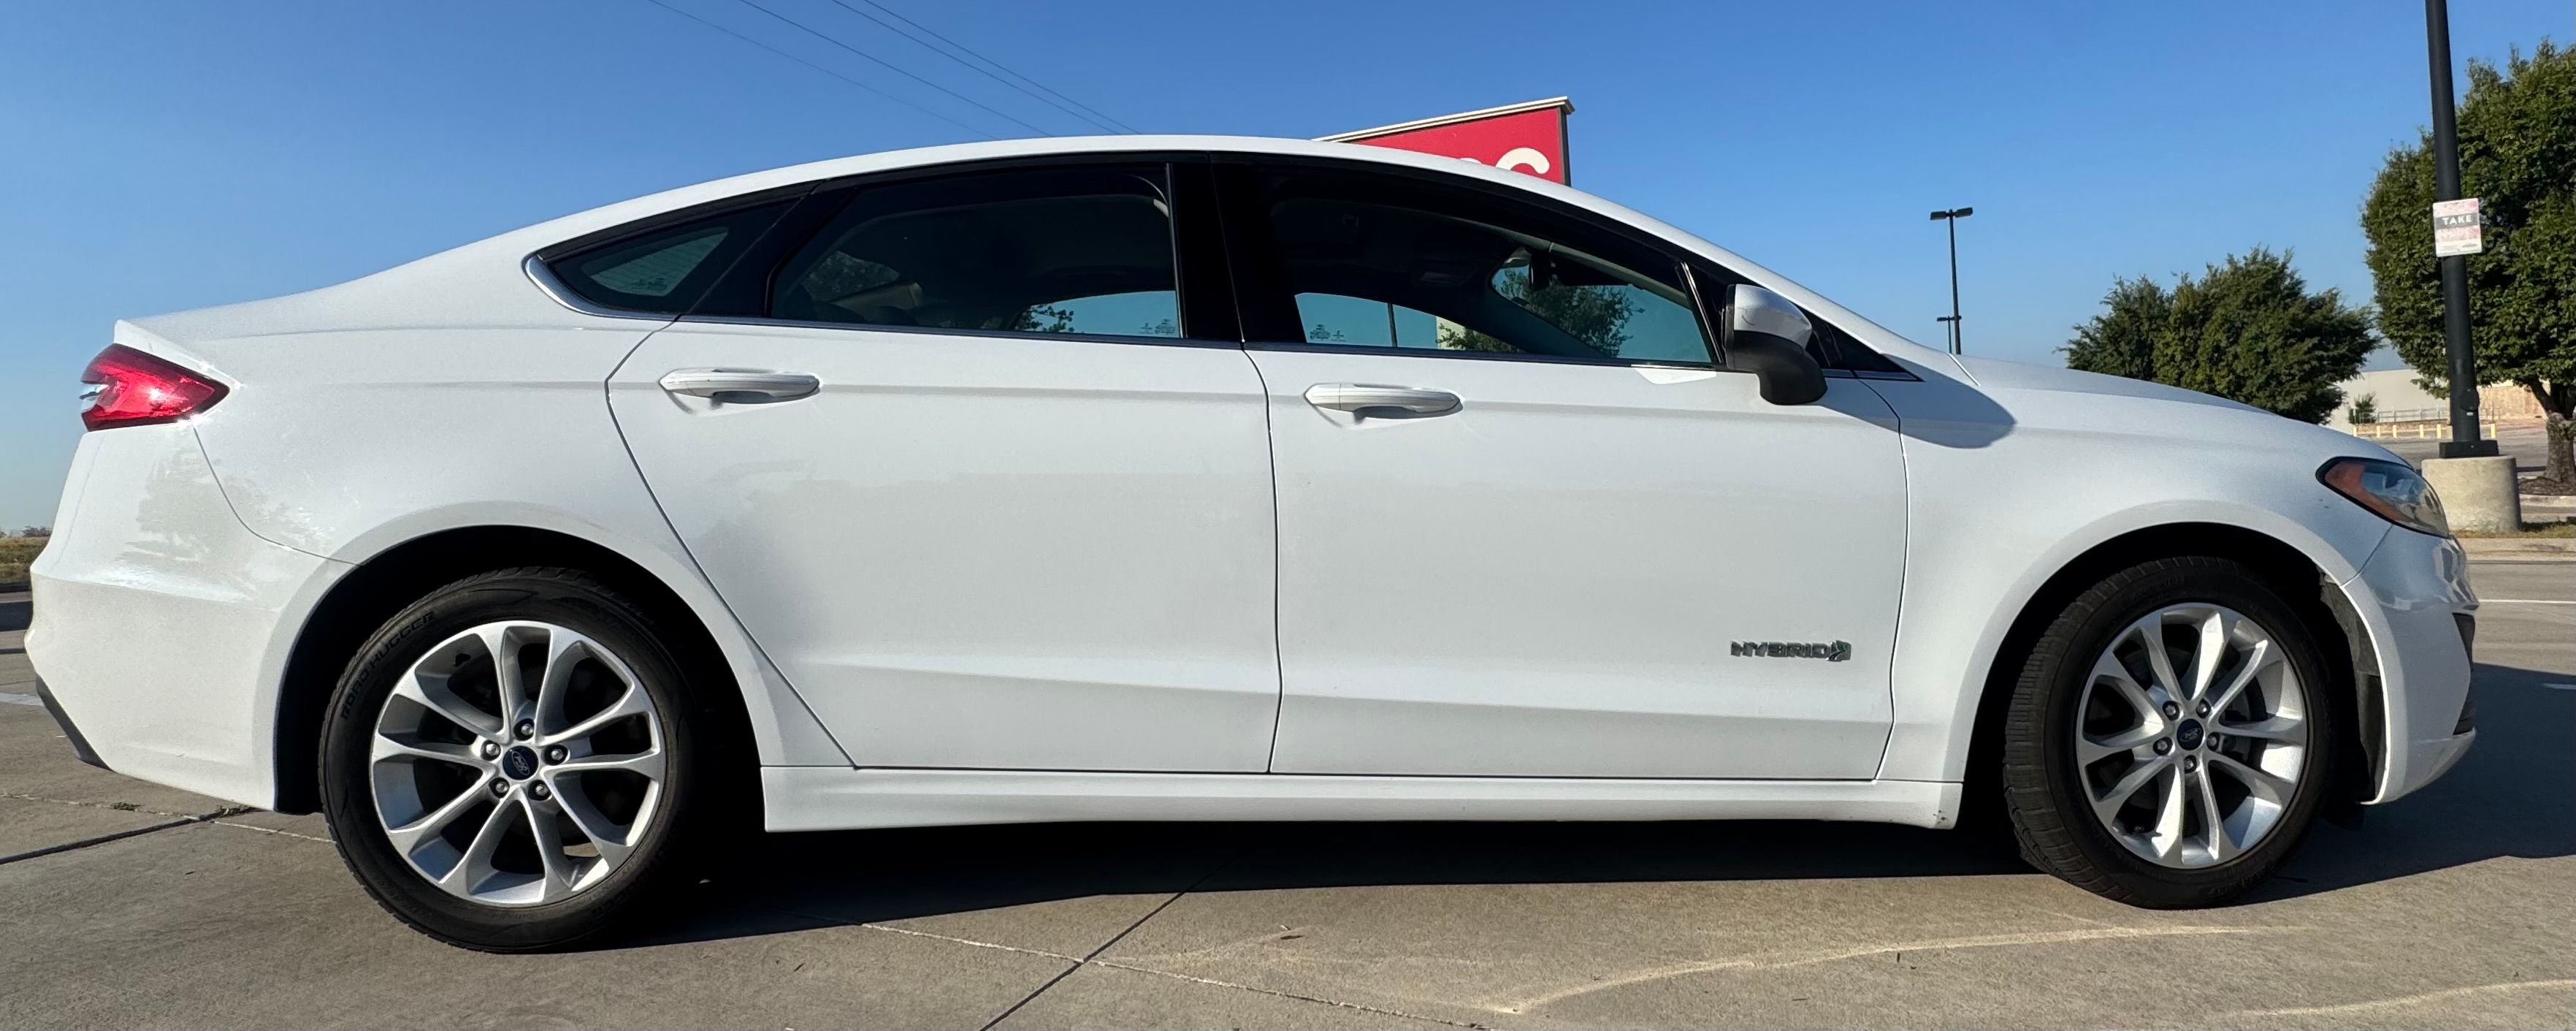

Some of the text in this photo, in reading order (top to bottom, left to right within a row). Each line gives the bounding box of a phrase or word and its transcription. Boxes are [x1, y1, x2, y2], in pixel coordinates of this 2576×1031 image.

[2442, 215, 2472, 225] TAKE
[369, 612, 435, 669] HUGGER
[1731, 640, 1831, 658] HYBRID
